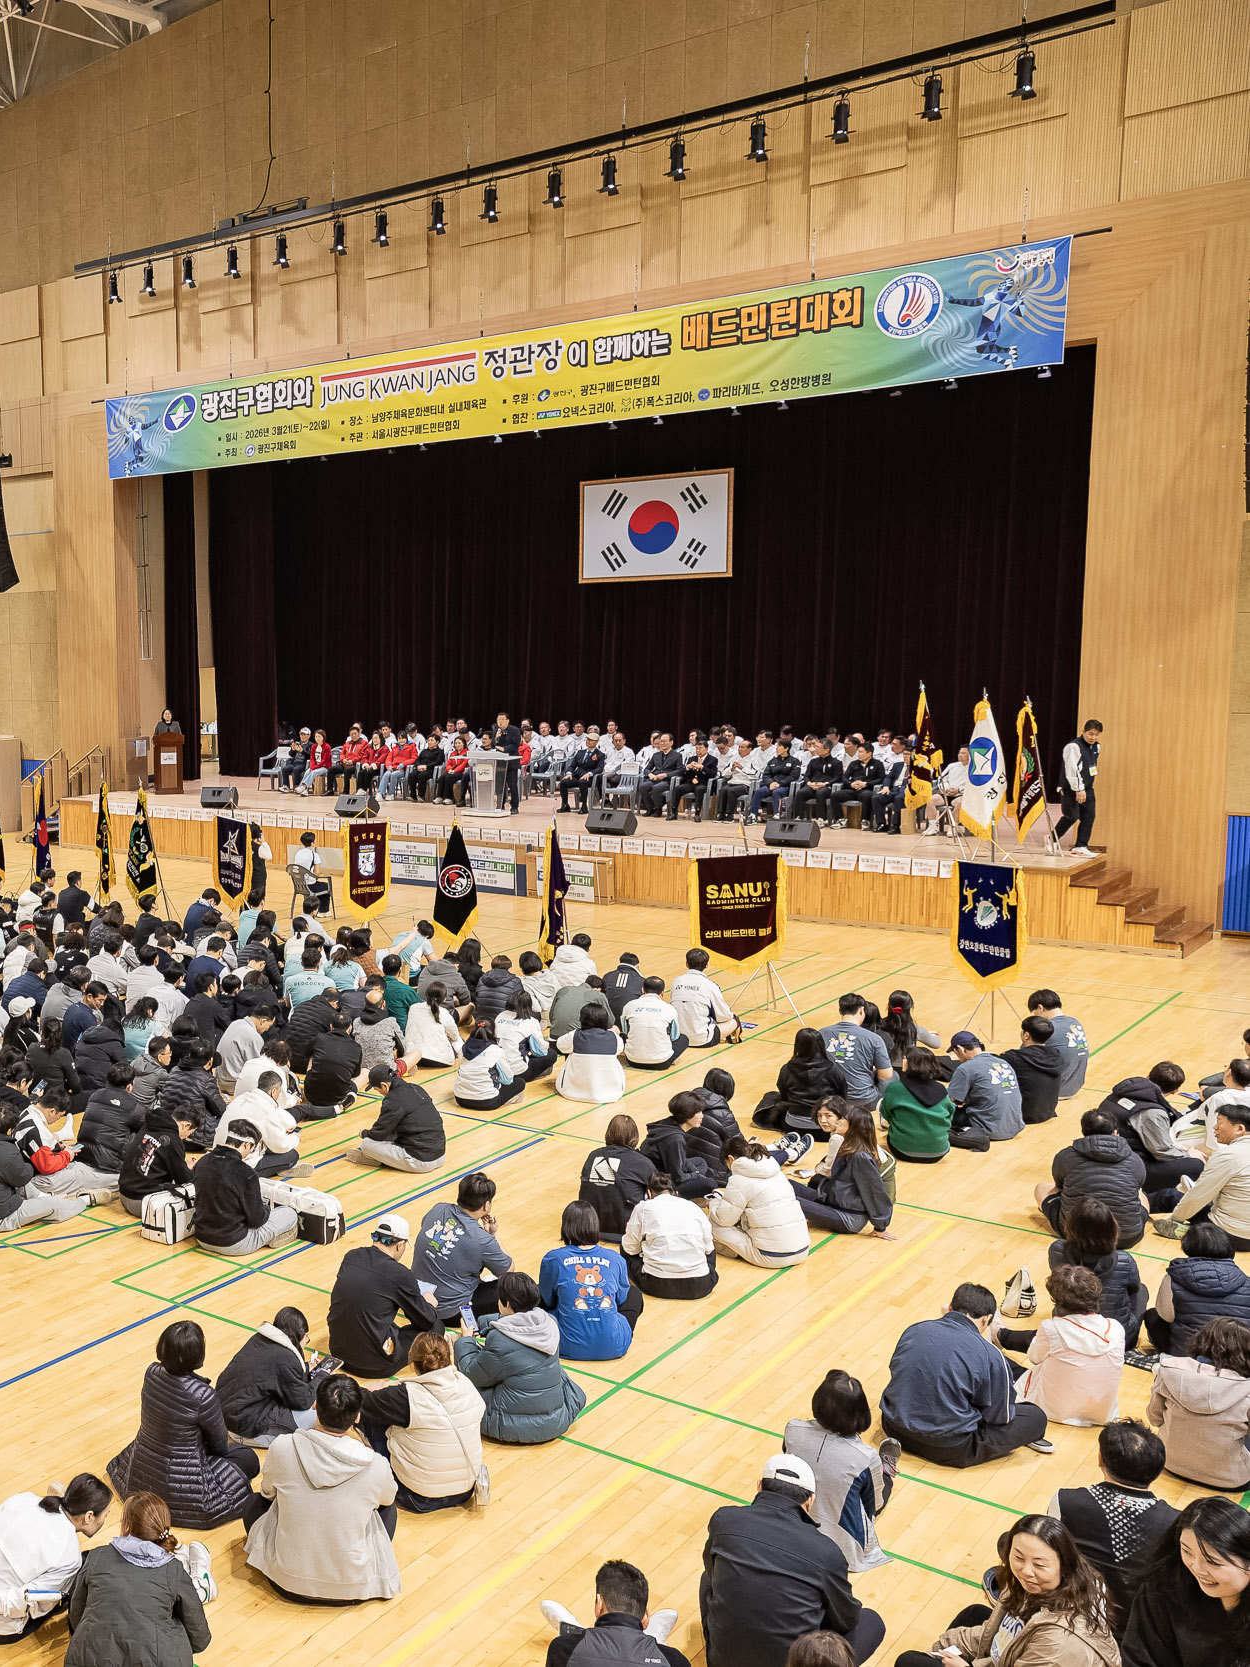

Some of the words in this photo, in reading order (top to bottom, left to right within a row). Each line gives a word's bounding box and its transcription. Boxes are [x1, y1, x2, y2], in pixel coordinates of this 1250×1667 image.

[897, 276, 917, 286] KOREA
[201, 376, 314, 422] 광진구협회와
[320, 382, 365, 408] JUNG
[370, 372, 424, 399] KWAN
[427, 364, 476, 393] JANG
[484, 340, 563, 378] 정관장
[567, 340, 588, 367] 이
[593, 329, 671, 365] 함께하는
[681, 286, 864, 350] 배드민턴대회
[580, 375, 660, 396] 광진구배드민턴협회
[769, 373, 832, 393] 오성한방병원
[372, 404, 445, 424] 남양주체육문화센터내
[448, 398, 487, 414] 실내체육관
[245, 427, 270, 440] 2026년
[372, 420, 460, 440] 서울시광진구배드민턴협회
[257, 440, 297, 454] 광진구체육회
[705, 930, 721, 939] 산의
[723, 928, 756, 938] 배드민턴
[563, 1256, 585, 1267] CHILL
[585, 1256, 592, 1264] &
[592, 1256, 611, 1268] PLAY
